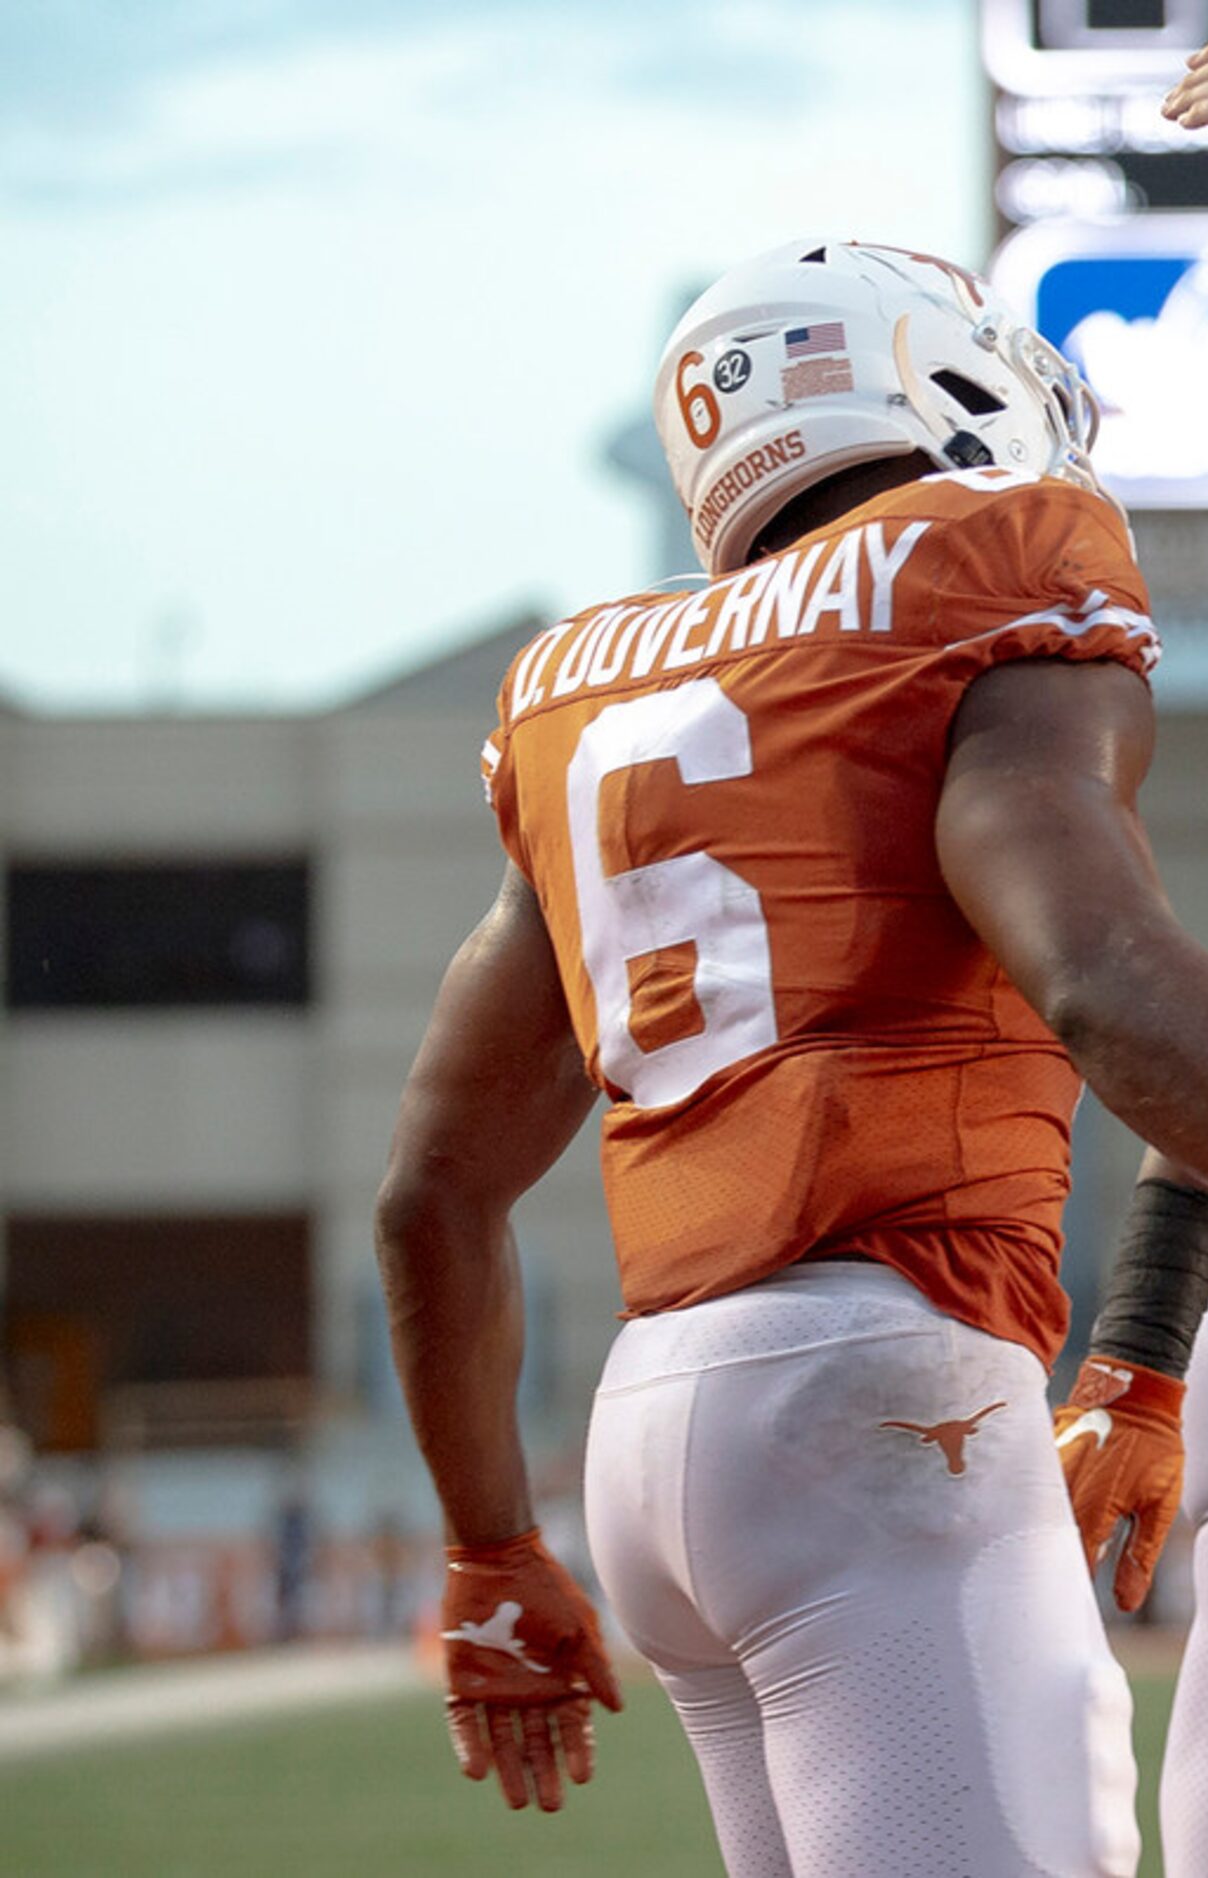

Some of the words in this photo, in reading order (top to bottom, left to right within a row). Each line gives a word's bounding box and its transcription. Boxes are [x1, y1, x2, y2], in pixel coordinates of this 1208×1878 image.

[676, 351, 721, 450] 6
[718, 354, 747, 388] 32
[695, 429, 807, 549] LONGHORNS
[552, 521, 933, 699] DUVERNAY
[567, 677, 777, 1110] 6
